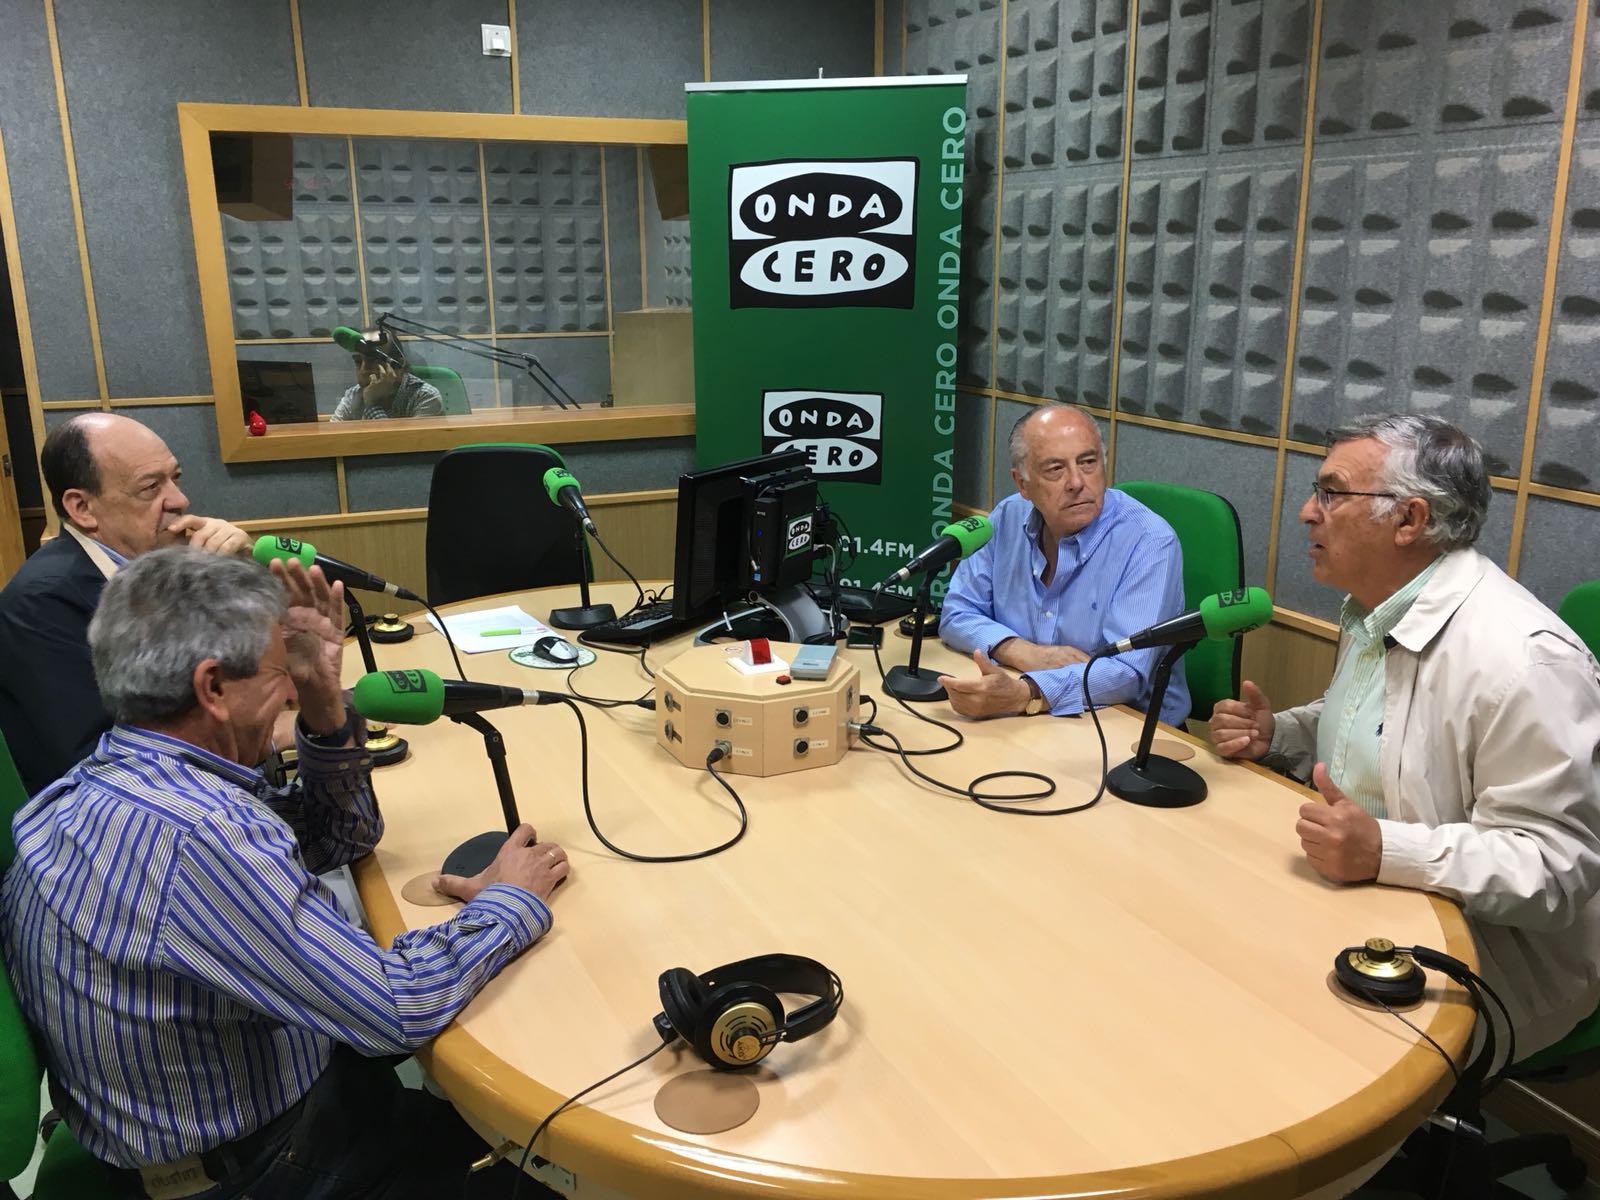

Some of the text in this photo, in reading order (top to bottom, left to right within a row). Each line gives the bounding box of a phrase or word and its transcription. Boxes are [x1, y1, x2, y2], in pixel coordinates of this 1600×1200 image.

[940, 106, 967, 211] CERO
[754, 192, 886, 223] ONDA
[762, 249, 887, 283] CERO
[936, 224, 962, 330] ONDA
[933, 342, 958, 435] CERO
[778, 408, 864, 429] ONDA
[784, 444, 864, 467] ERO
